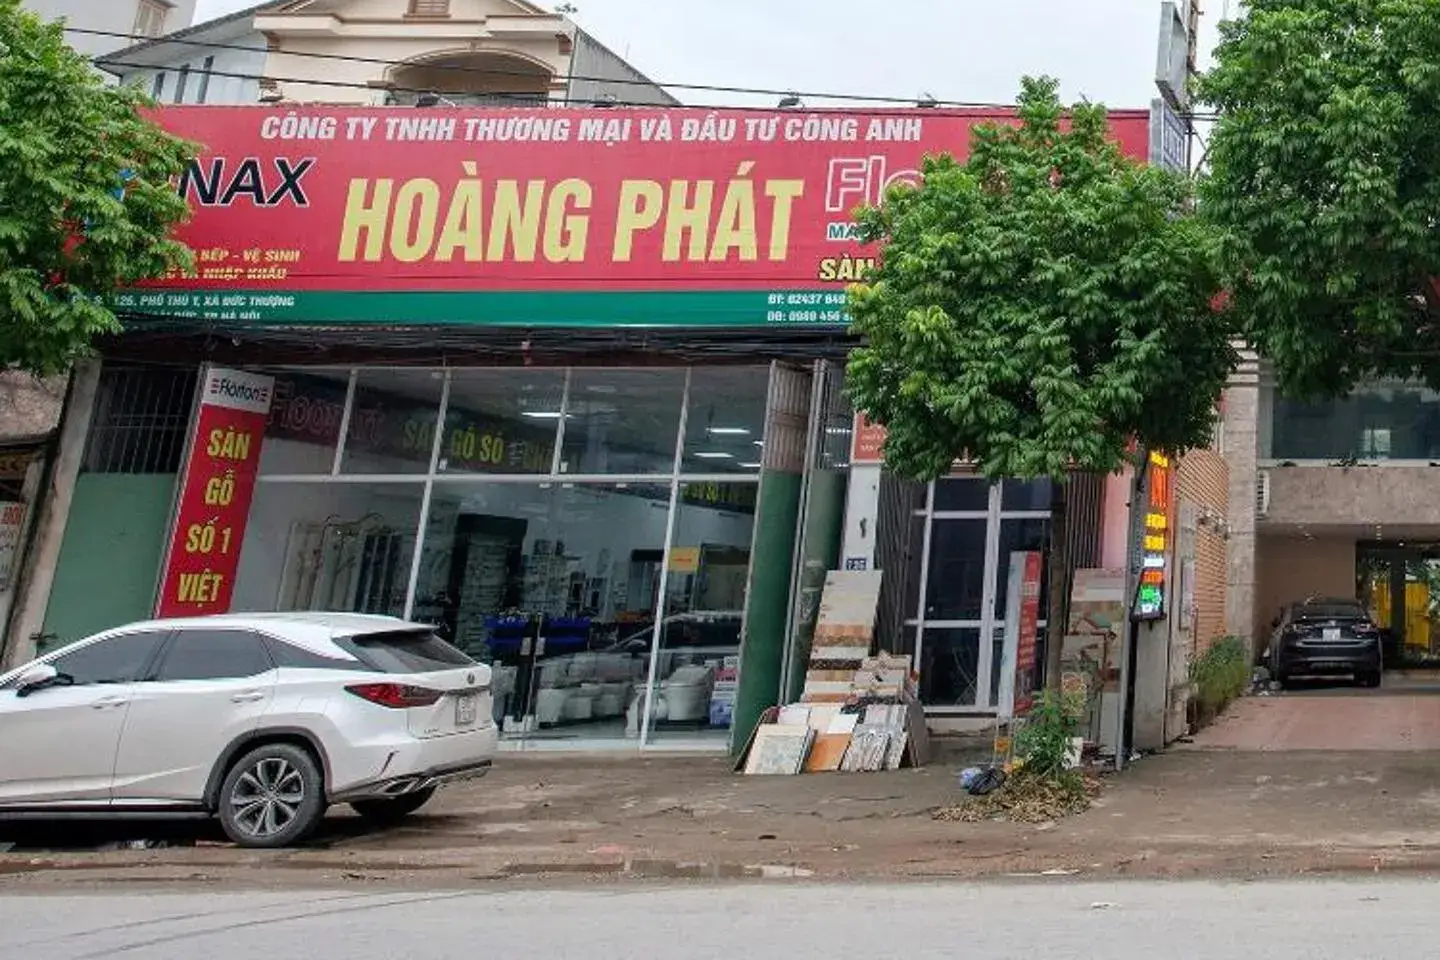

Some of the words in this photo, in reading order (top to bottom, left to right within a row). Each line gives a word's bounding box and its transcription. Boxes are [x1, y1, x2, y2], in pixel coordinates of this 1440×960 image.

[260, 111, 337, 140] CÔNG
[345, 117, 378, 140] TY
[385, 117, 456, 141] TNHH
[463, 117, 571, 141] THƯƠNG
[577, 117, 632, 146] MẠI
[639, 115, 673, 141] VÀ
[681, 110, 736, 142] ĐẦU
[744, 117, 781, 141] TƯ
[784, 112, 858, 141] CÔNG
[864, 118, 922, 141] ANH
[172, 156, 317, 208] NAX
[338, 159, 594, 263] HOÀNG
[611, 160, 806, 263] PHÁT
[818, 251, 877, 281] SÀN
[207, 426, 250, 461] SÀN
[205, 469, 236, 506] GỖ
[185, 516, 216, 554] SỐ
[221, 527, 232, 555] 1
[178, 568, 223, 608] VIỆT
